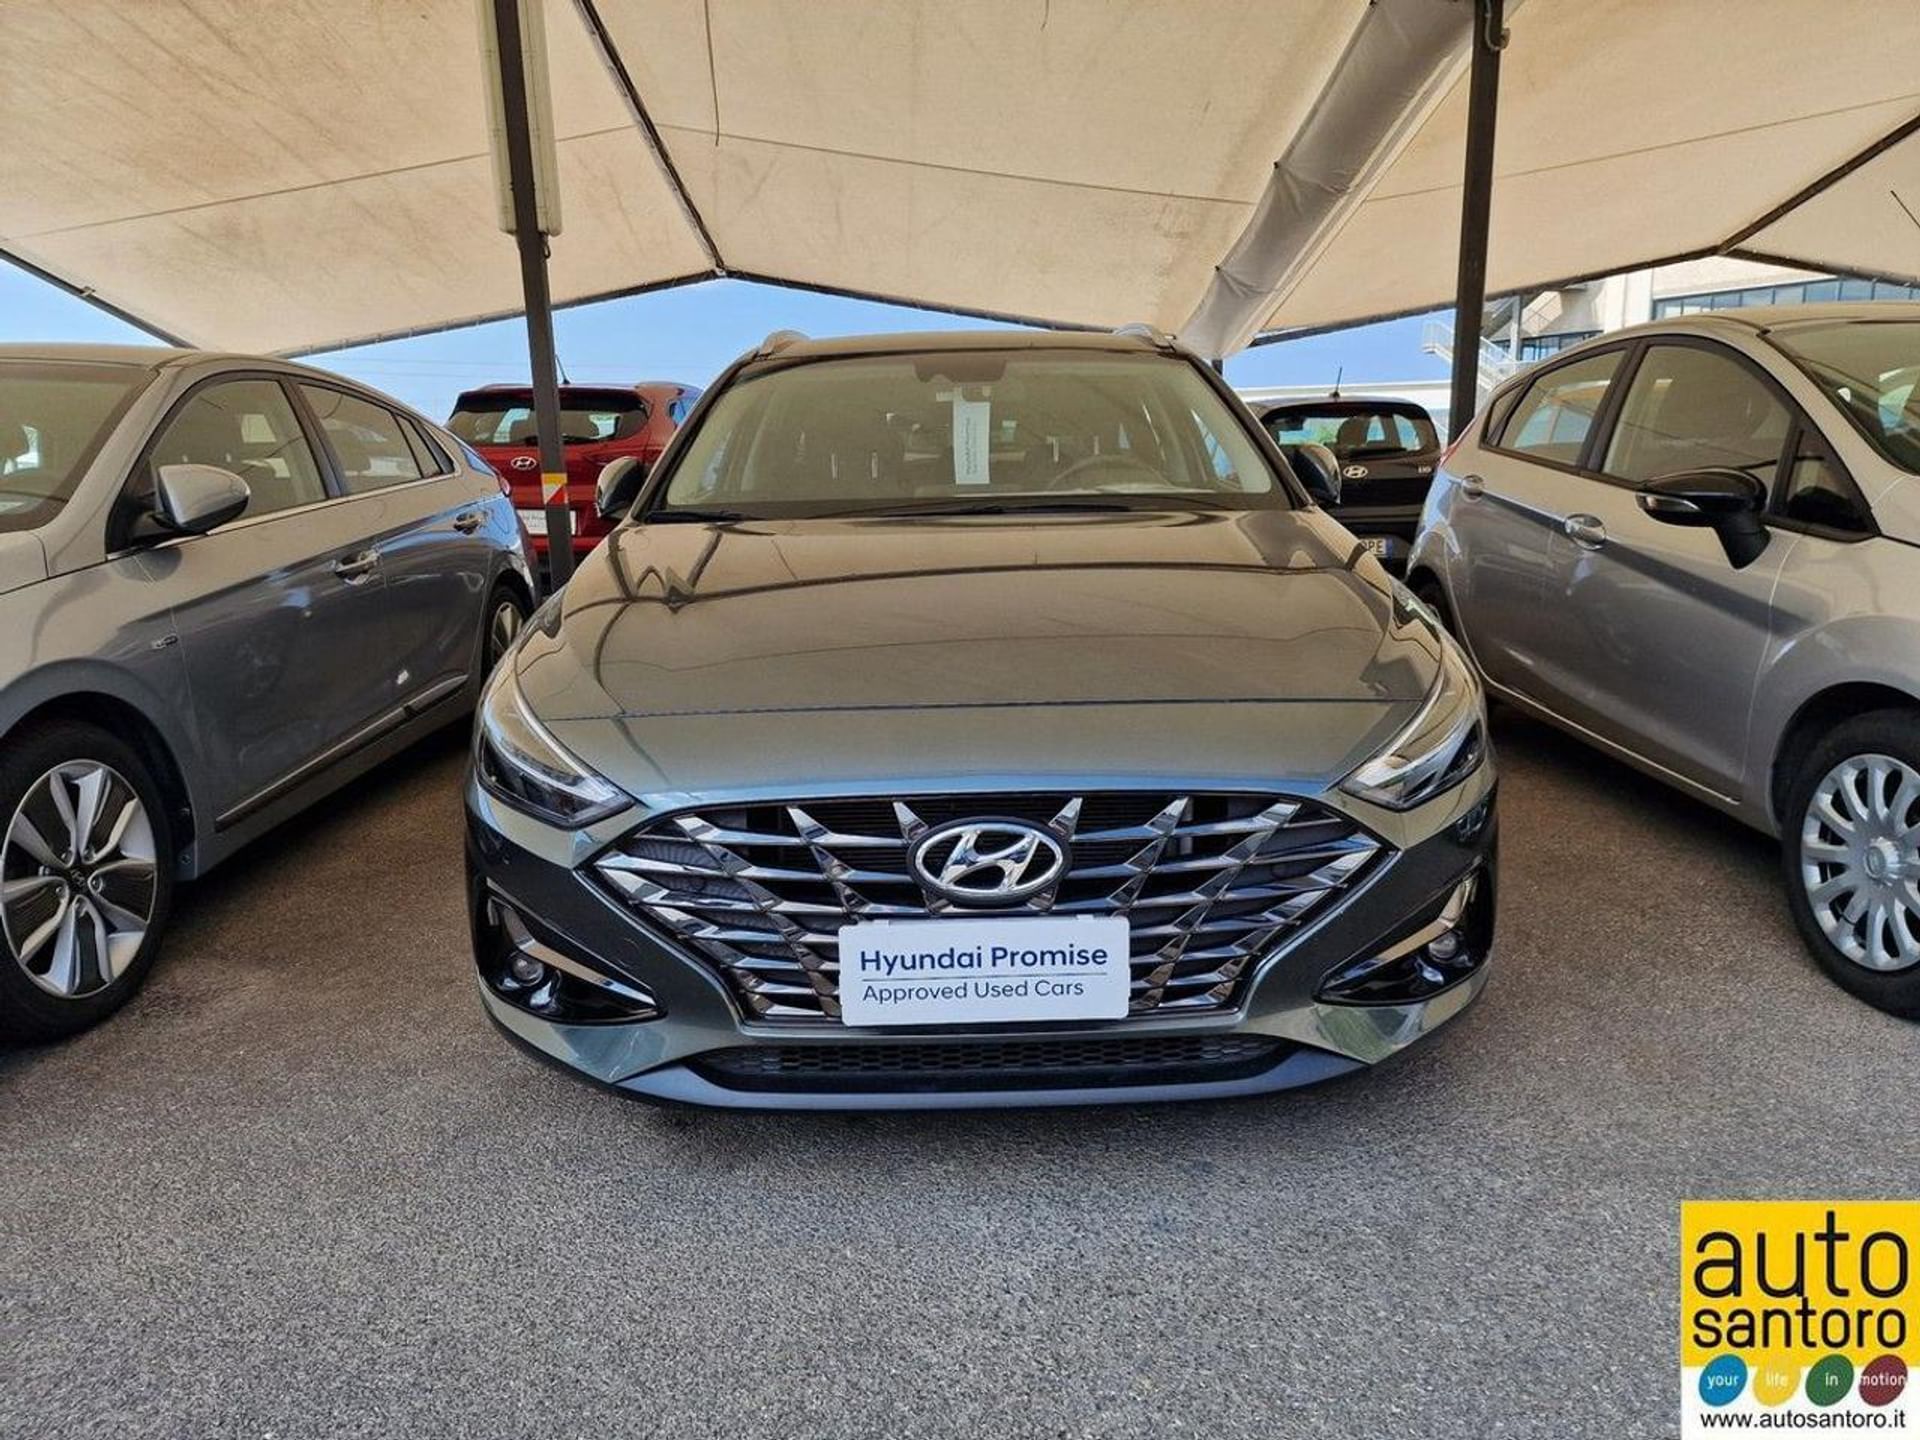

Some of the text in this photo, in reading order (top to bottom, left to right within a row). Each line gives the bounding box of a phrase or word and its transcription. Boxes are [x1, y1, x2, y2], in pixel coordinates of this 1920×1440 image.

[861, 944, 1108, 976] Hyundai Promise
[862, 978, 1084, 1004] Approved Used Cars
